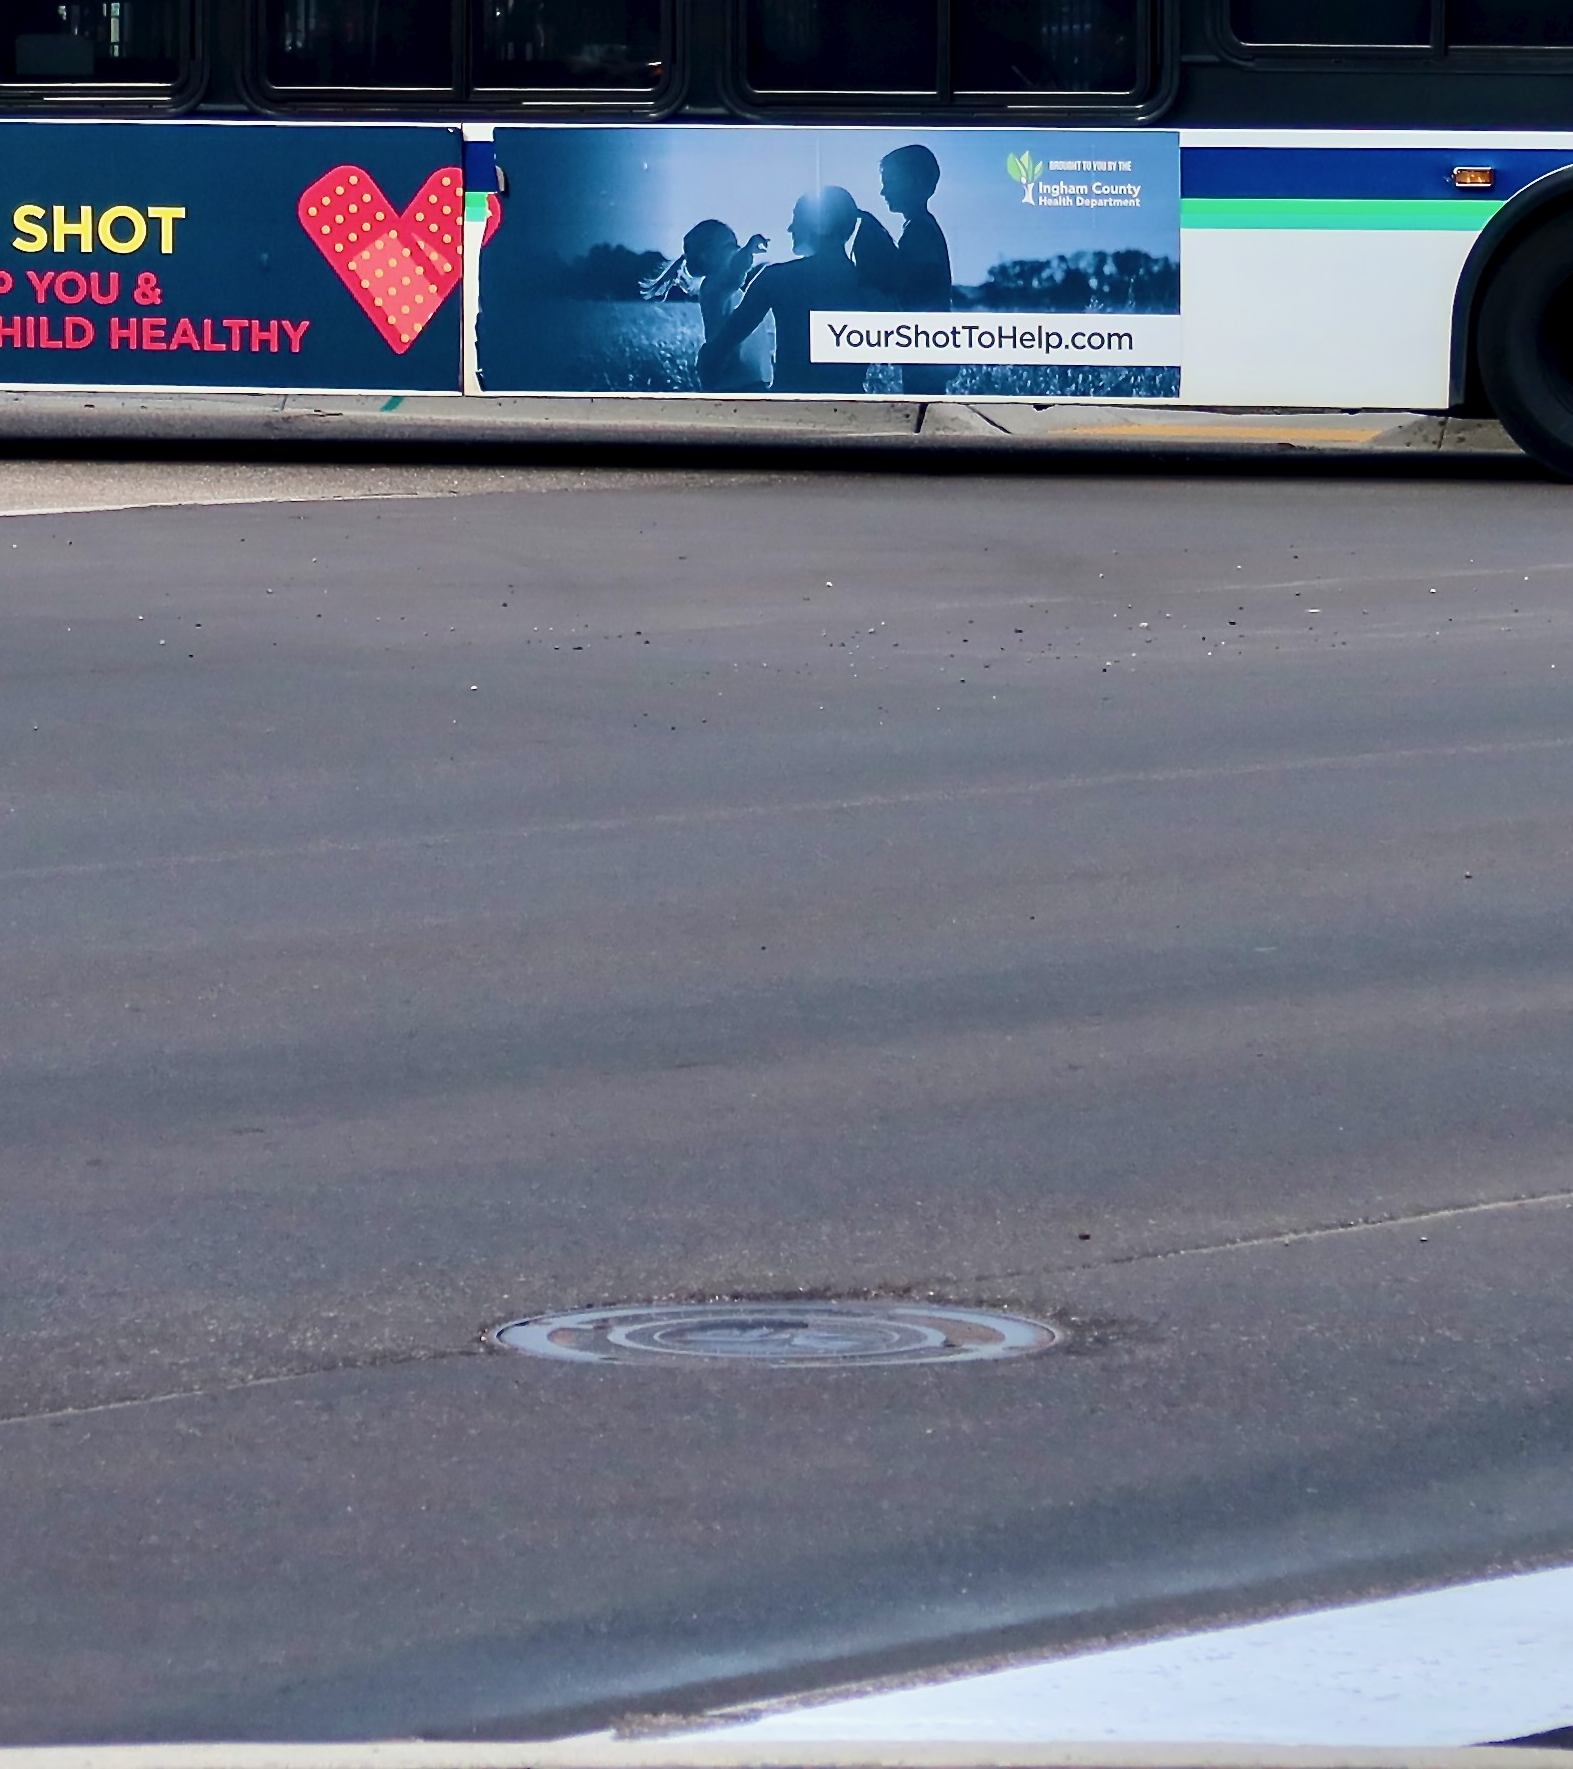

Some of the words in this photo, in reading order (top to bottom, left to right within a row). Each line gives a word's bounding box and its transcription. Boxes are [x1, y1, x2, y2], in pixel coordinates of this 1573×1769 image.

[1038, 181, 1088, 197] Ingham
[1091, 182, 1142, 198] County
[1038, 196, 1073, 207] Health
[1076, 196, 1141, 208] Department
[11, 204, 187, 254] SHOT
[26, 270, 120, 305] YOU
[133, 271, 163, 306] &
[110, 316, 310, 353] HEALTHY
[826, 323, 1134, 354] YourShotToHelp.com
